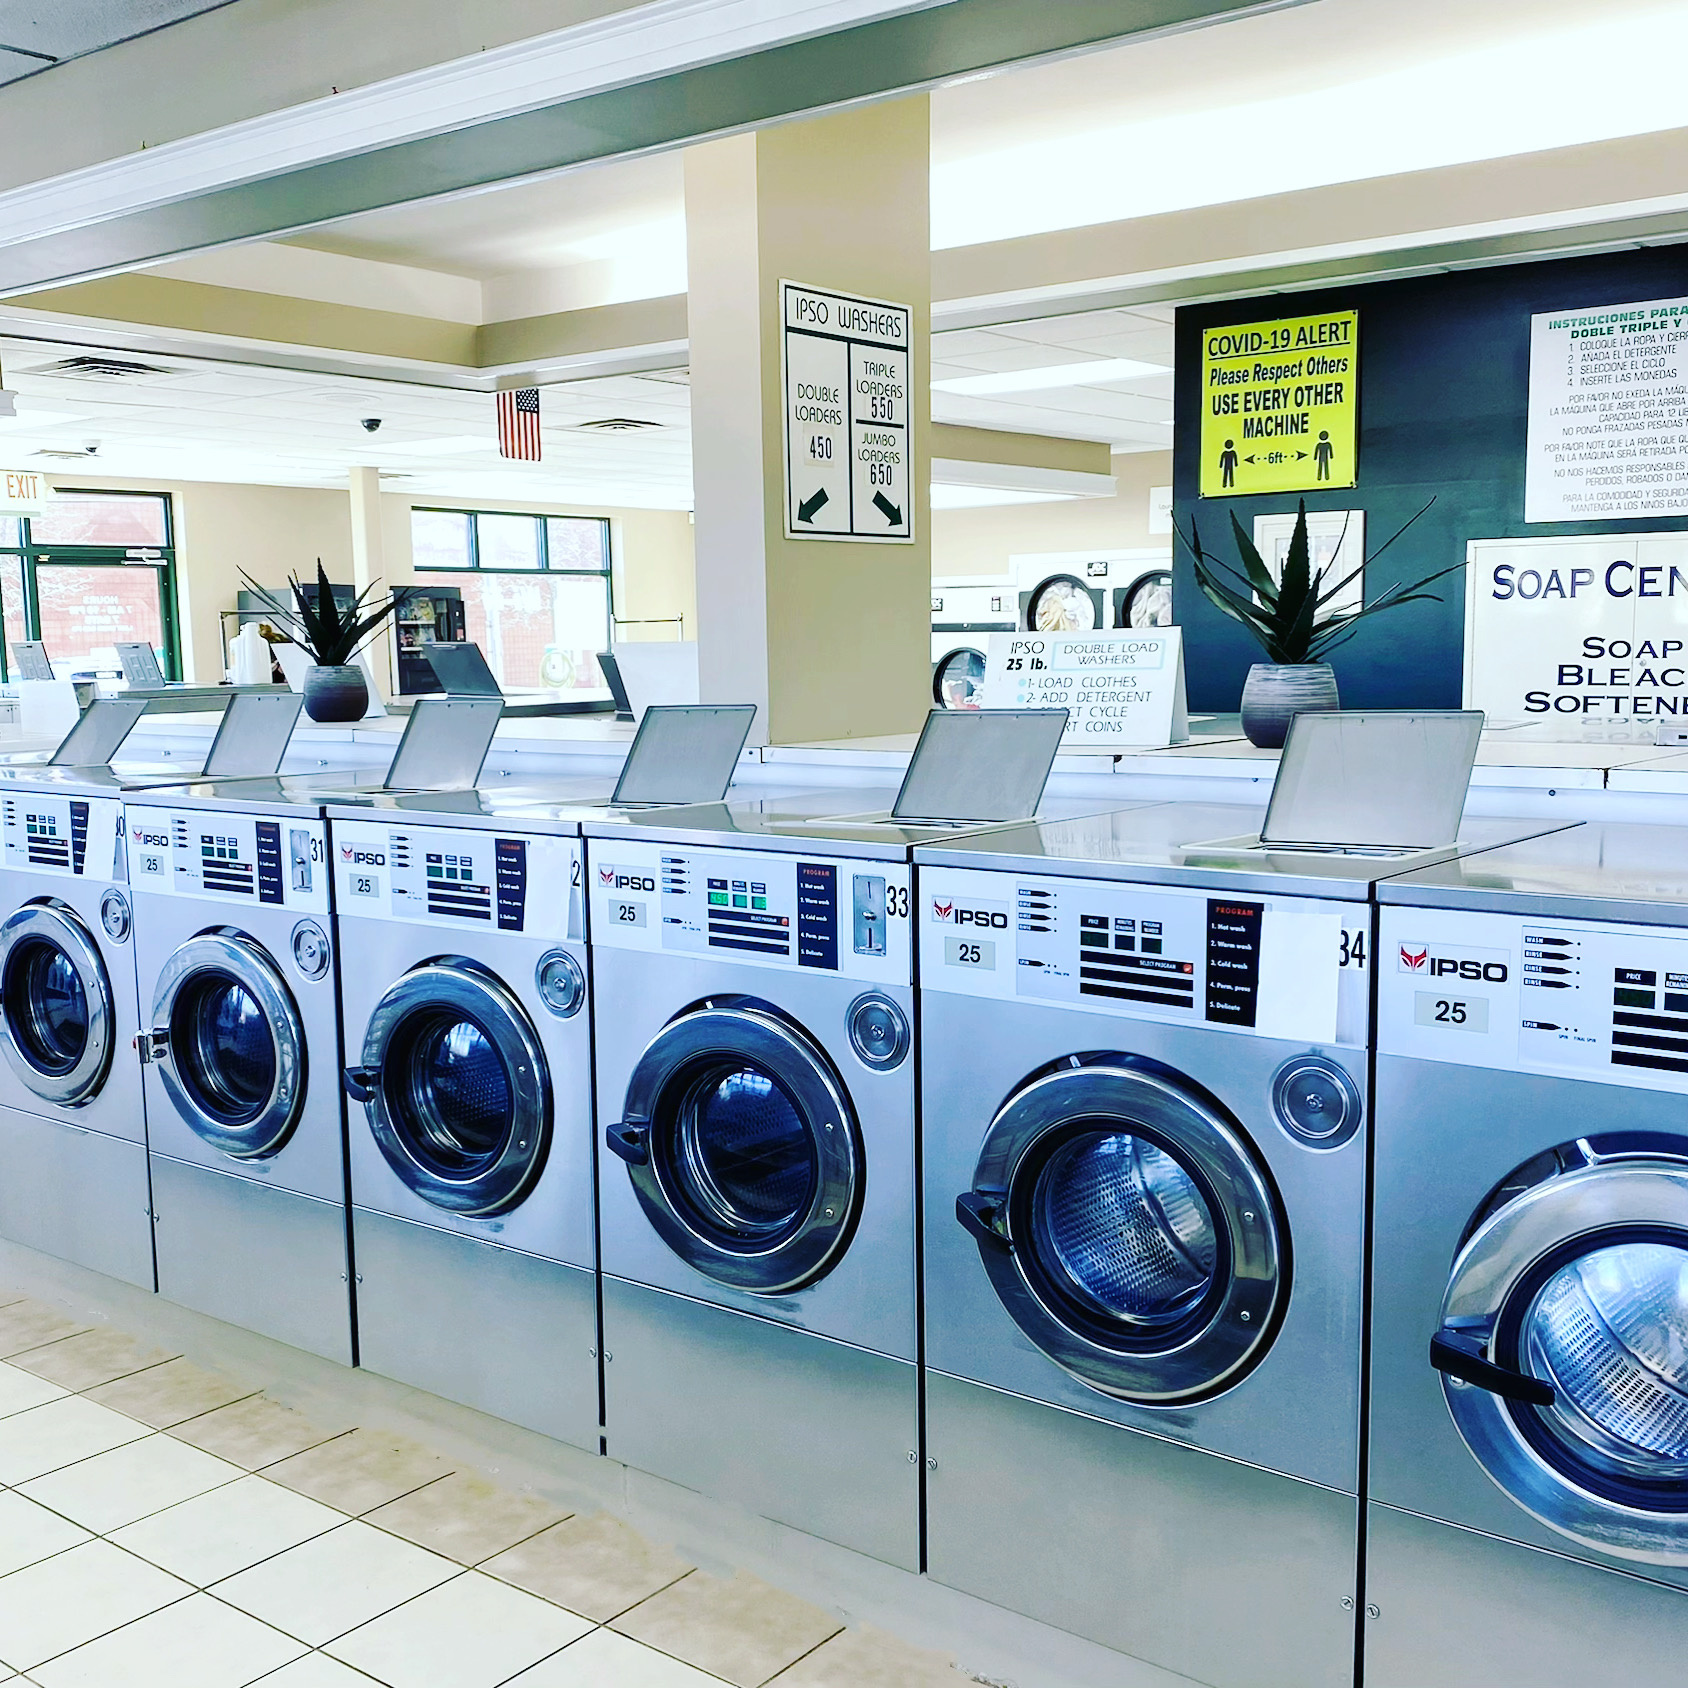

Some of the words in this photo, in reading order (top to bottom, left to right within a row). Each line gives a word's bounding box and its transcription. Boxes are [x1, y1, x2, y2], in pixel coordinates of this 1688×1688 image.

[796, 297, 828, 324] IPSO
[839, 305, 901, 338] WASHERS
[1549, 311, 1645, 329] INSTRUCIONES
[1650, 305, 1688, 318] PARA
[1571, 326, 1614, 339] DOBLE
[1620, 320, 1668, 333] TRIPLE
[1673, 319, 1682, 327] Y
[1208, 329, 1290, 356] COVID-19
[1296, 321, 1351, 346] ALERT
[1580, 338, 1617, 350] COLOQUE
[1620, 337, 1630, 346] LA
[1633, 334, 1656, 345] ROPA
[1659, 334, 1664, 342] Y
[1613, 350, 1621, 359] EL
[1624, 345, 1677, 358] DETERGENTE
[864, 361, 895, 378] TRIPLE
[1210, 368, 1249, 386] Please
[1253, 360, 1302, 384] Respect
[1307, 355, 1348, 375] Others
[1580, 361, 1627, 375] SELECCIONE
[1631, 360, 1639, 370] EL
[1642, 357, 1665, 368] CICLO
[1580, 374, 1612, 386] INSERTE
[1615, 372, 1631, 383] LAS
[1634, 369, 1677, 381] MONEDAS
[797, 384, 839, 403] DOUBLE
[857, 379, 902, 399] LOADERS
[1212, 393, 1239, 415] USE
[1243, 388, 1290, 412] EVERY
[1295, 383, 1343, 407] OTHER
[795, 405, 842, 425] LOADERS
[871, 397, 893, 421] 550
[1243, 413, 1309, 439] MACHINE
[1562, 427, 1573, 436] NO
[1576, 425, 1601, 434] PONGA
[1605, 422, 1644, 432] FRAZADAS
[1647, 418, 1683, 429] PESADAS
[810, 436, 832, 459] 450
[862, 432, 896, 447] JUMBO
[858, 449, 901, 464] LOADERS
[870, 464, 892, 486] 650
[7, 474, 37, 498] EXIT
[1492, 564, 1595, 600] SOAP
[1011, 641, 1044, 654] IPSO
[1064, 644, 1114, 654] DOUBLE
[1122, 643, 1158, 653] LOAD
[1582, 637, 1683, 658] SOAP
[1007, 659, 1022, 670] 25
[1030, 658, 1047, 670] lb.
[1078, 655, 1136, 665] WASHERS
[1039, 678, 1073, 688] LOAD
[1082, 676, 1137, 687] CLOTHES
[1558, 664, 1685, 686] BLEAC
[1040, 692, 1068, 703] ADD
[1077, 691, 1152, 703] DETERGENT
[1524, 691, 1688, 714] SOFTEN
[1090, 706, 1128, 717] CYCLE
[1086, 721, 1123, 733] COINS
[143, 834, 168, 846] IPSO
[311, 838, 323, 863] 31
[354, 853, 385, 865] IPSO
[147, 859, 157, 871] 25
[572, 860, 580, 887] 2
[358, 878, 371, 893] 25
[616, 875, 655, 891] IPSO
[887, 886, 908, 918] 33
[619, 905, 635, 921] 25
[954, 909, 1008, 928] IPSO
[1215, 907, 1253, 916] PROGRAM
[959, 944, 981, 962] 25
[1430, 957, 1508, 983] IPSO
[1435, 1000, 1467, 1023] 25
